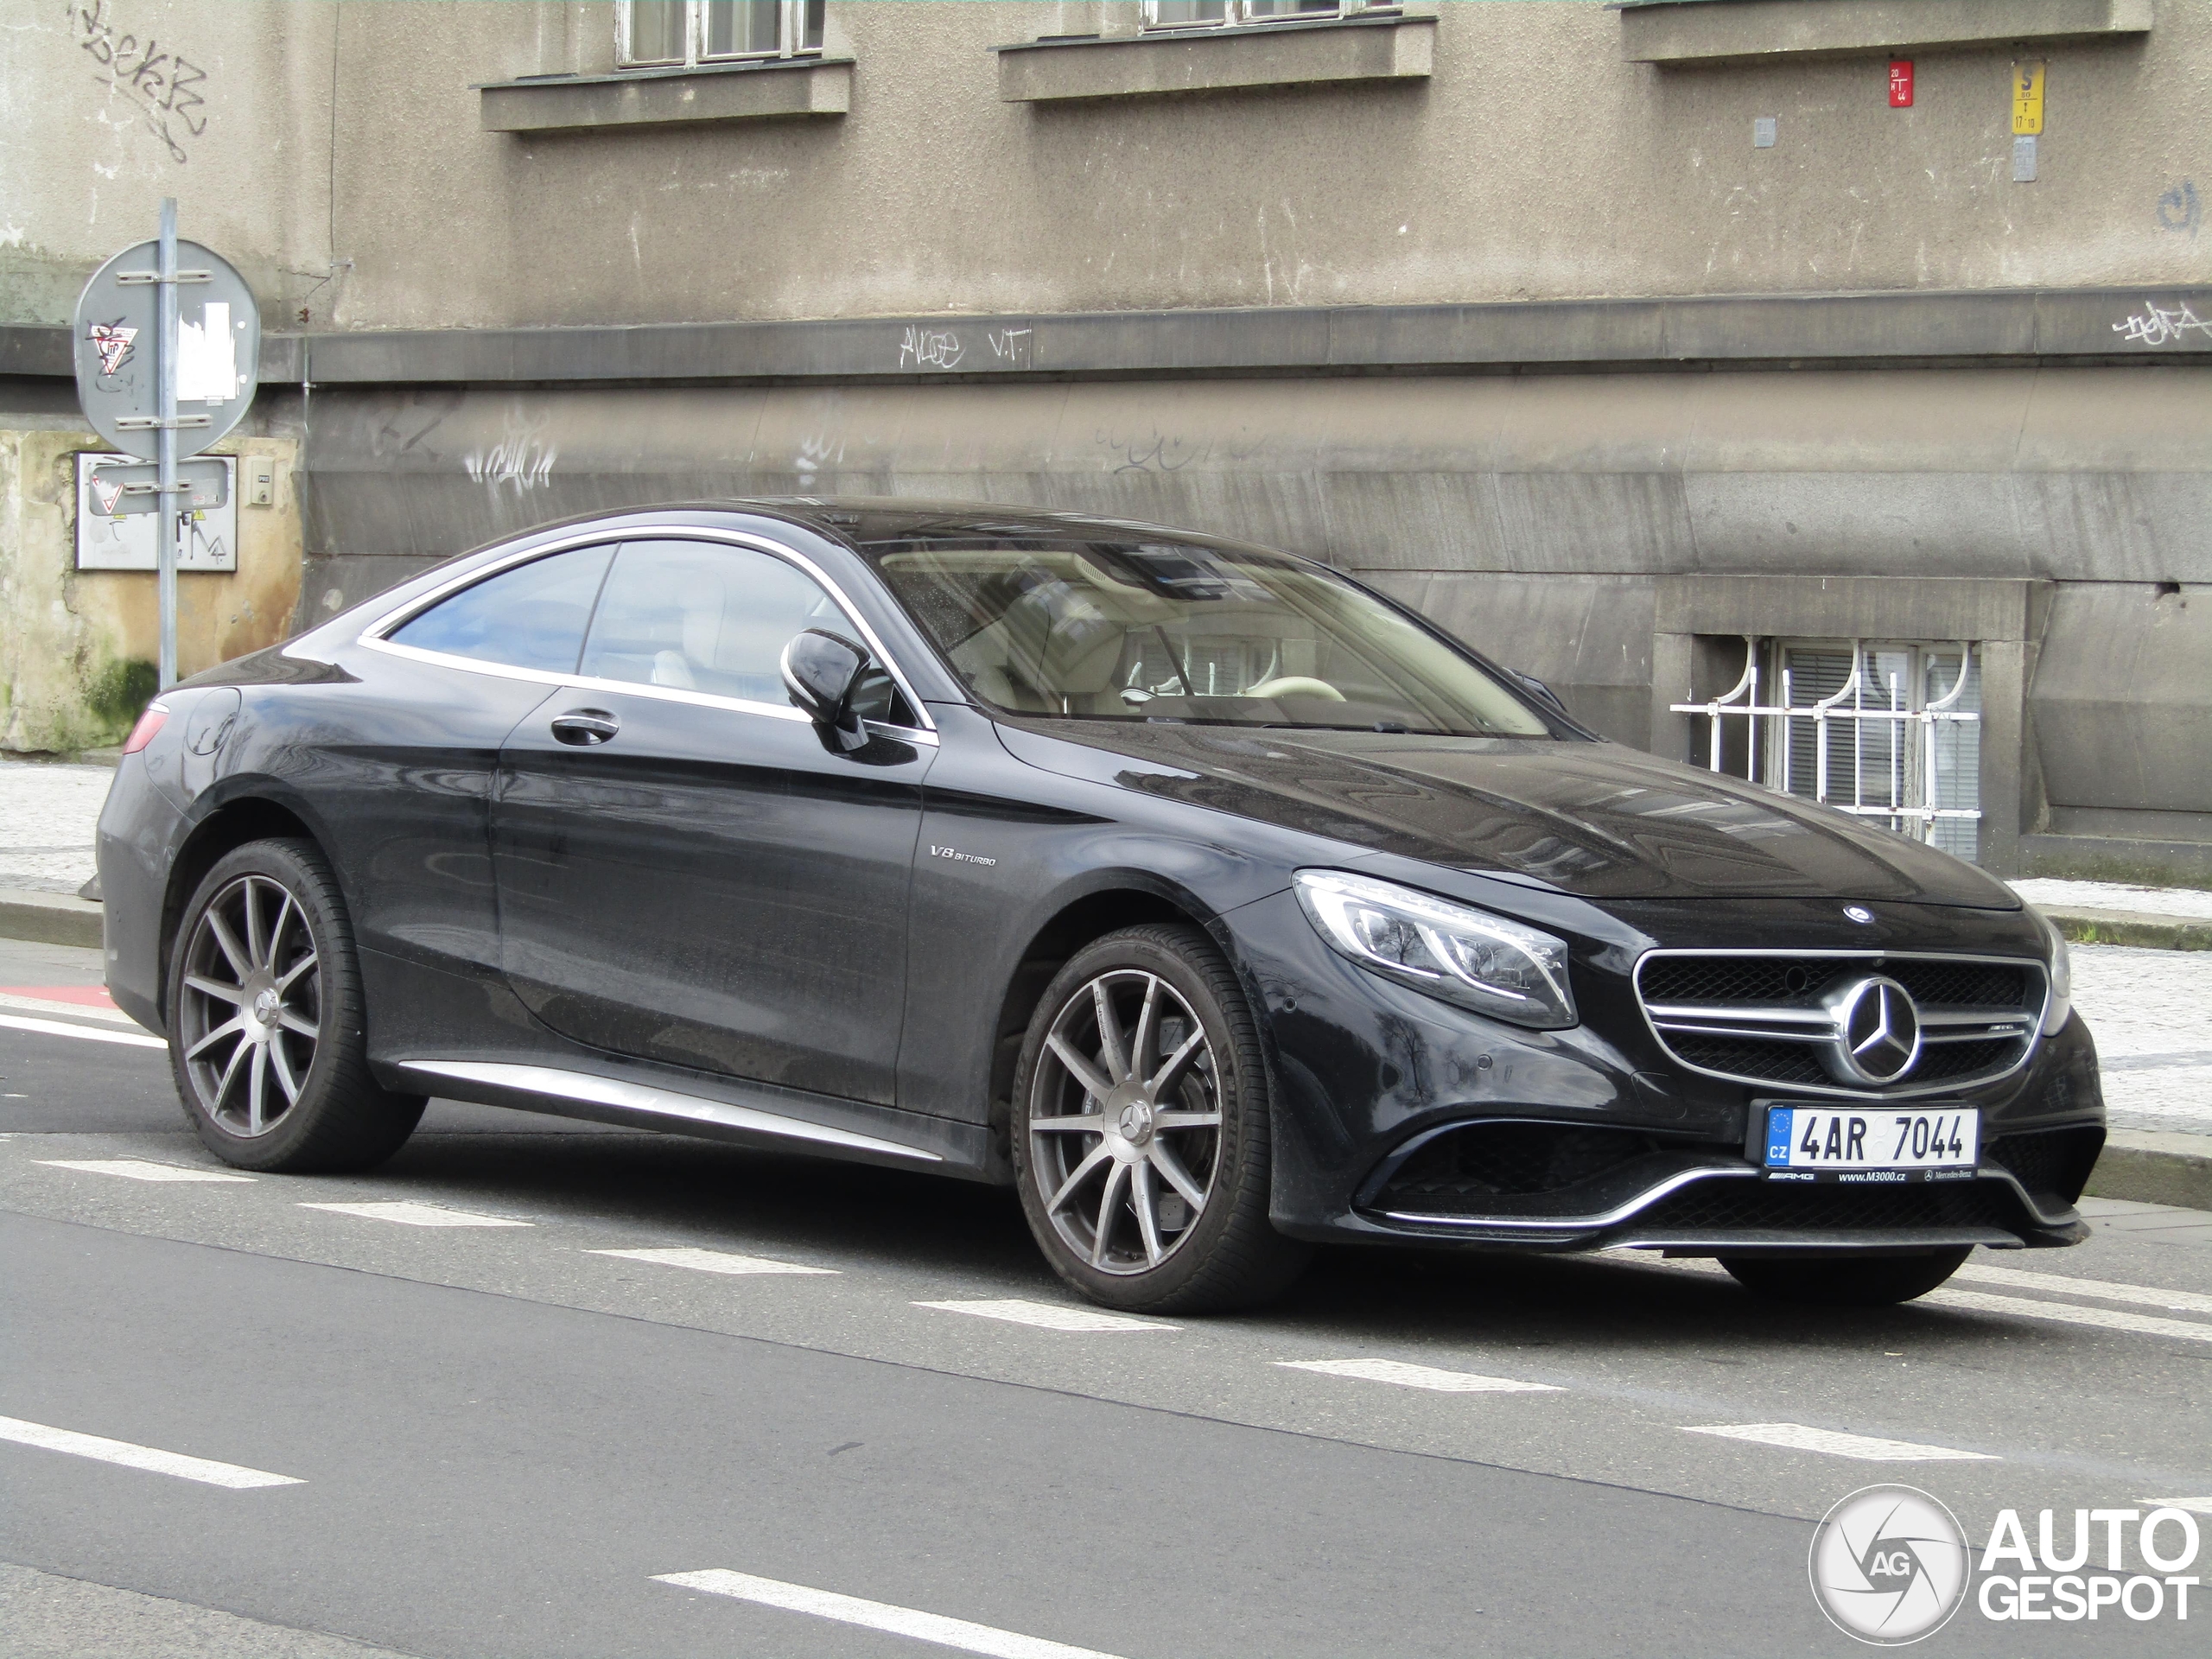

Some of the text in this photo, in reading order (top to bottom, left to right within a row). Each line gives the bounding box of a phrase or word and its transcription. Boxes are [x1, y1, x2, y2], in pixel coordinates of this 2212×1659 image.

[1891, 68, 1899, 78] 20
[2021, 67, 2031, 91] S
[931, 845, 996, 867] V8 BITURBO
[1799, 1116, 1962, 1160] 4AR 7044
[1770, 1146, 1787, 1159] CZ
[1838, 1171, 1906, 1182] www.M3000.cz
